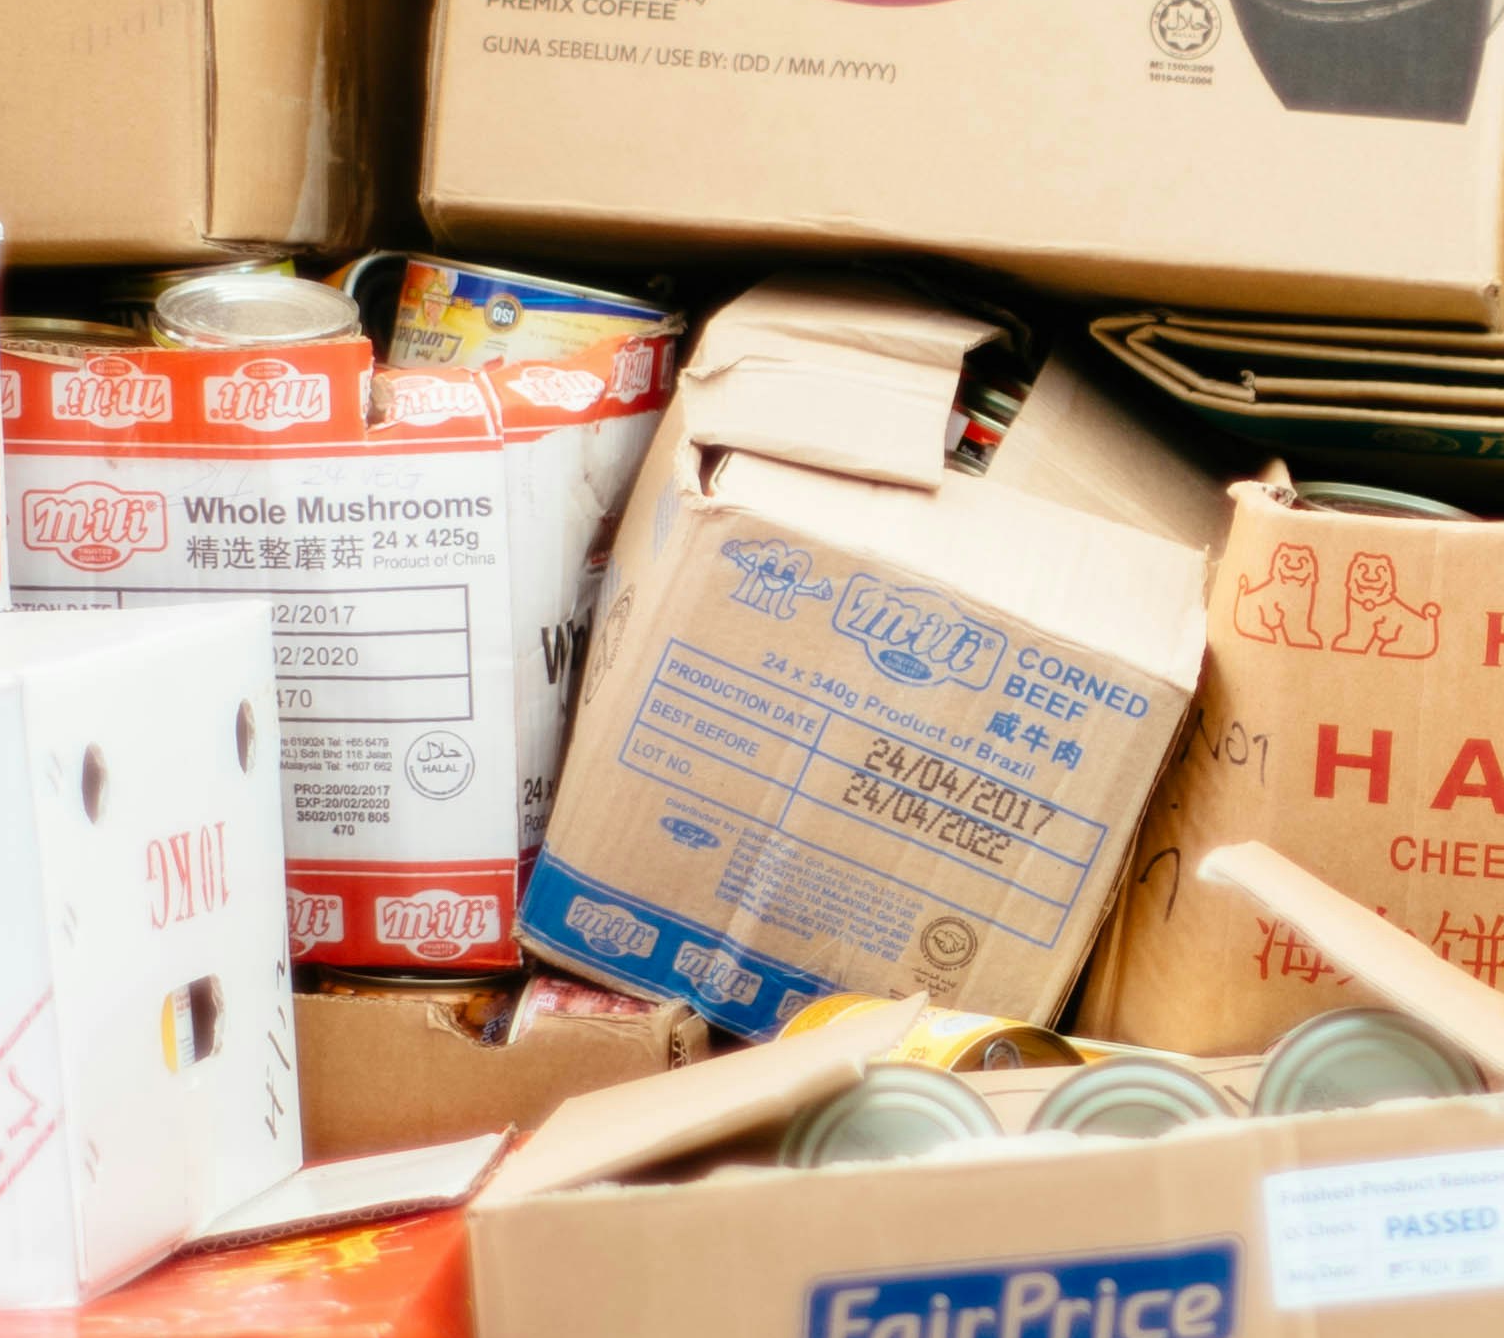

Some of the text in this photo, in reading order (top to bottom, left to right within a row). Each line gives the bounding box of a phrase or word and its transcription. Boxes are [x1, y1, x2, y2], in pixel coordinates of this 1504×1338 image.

[481, 35, 637, 64] GUNA SEBELUM
[184, 492, 493, 525] Whole Mushrooms
[185, 533, 366, 572] 精选整蘑菇
[372, 526, 481, 550] 24 425g
[449, 551, 497, 568] China
[1001, 673, 1088, 726] BEEF
[1015, 645, 1152, 722] CORNED
[649, 695, 762, 760] BEST BEFORE
[863, 693, 1038, 782] Product Brazil
[983, 709, 1085, 773] 咸牛肉
[295, 796, 391, 811] EXP:20/02/2020
[861, 735, 1062, 839] 24/04/2017
[841, 770, 1015, 868] 24/04/2022
[1383, 1205, 1501, 1244] PASSED
